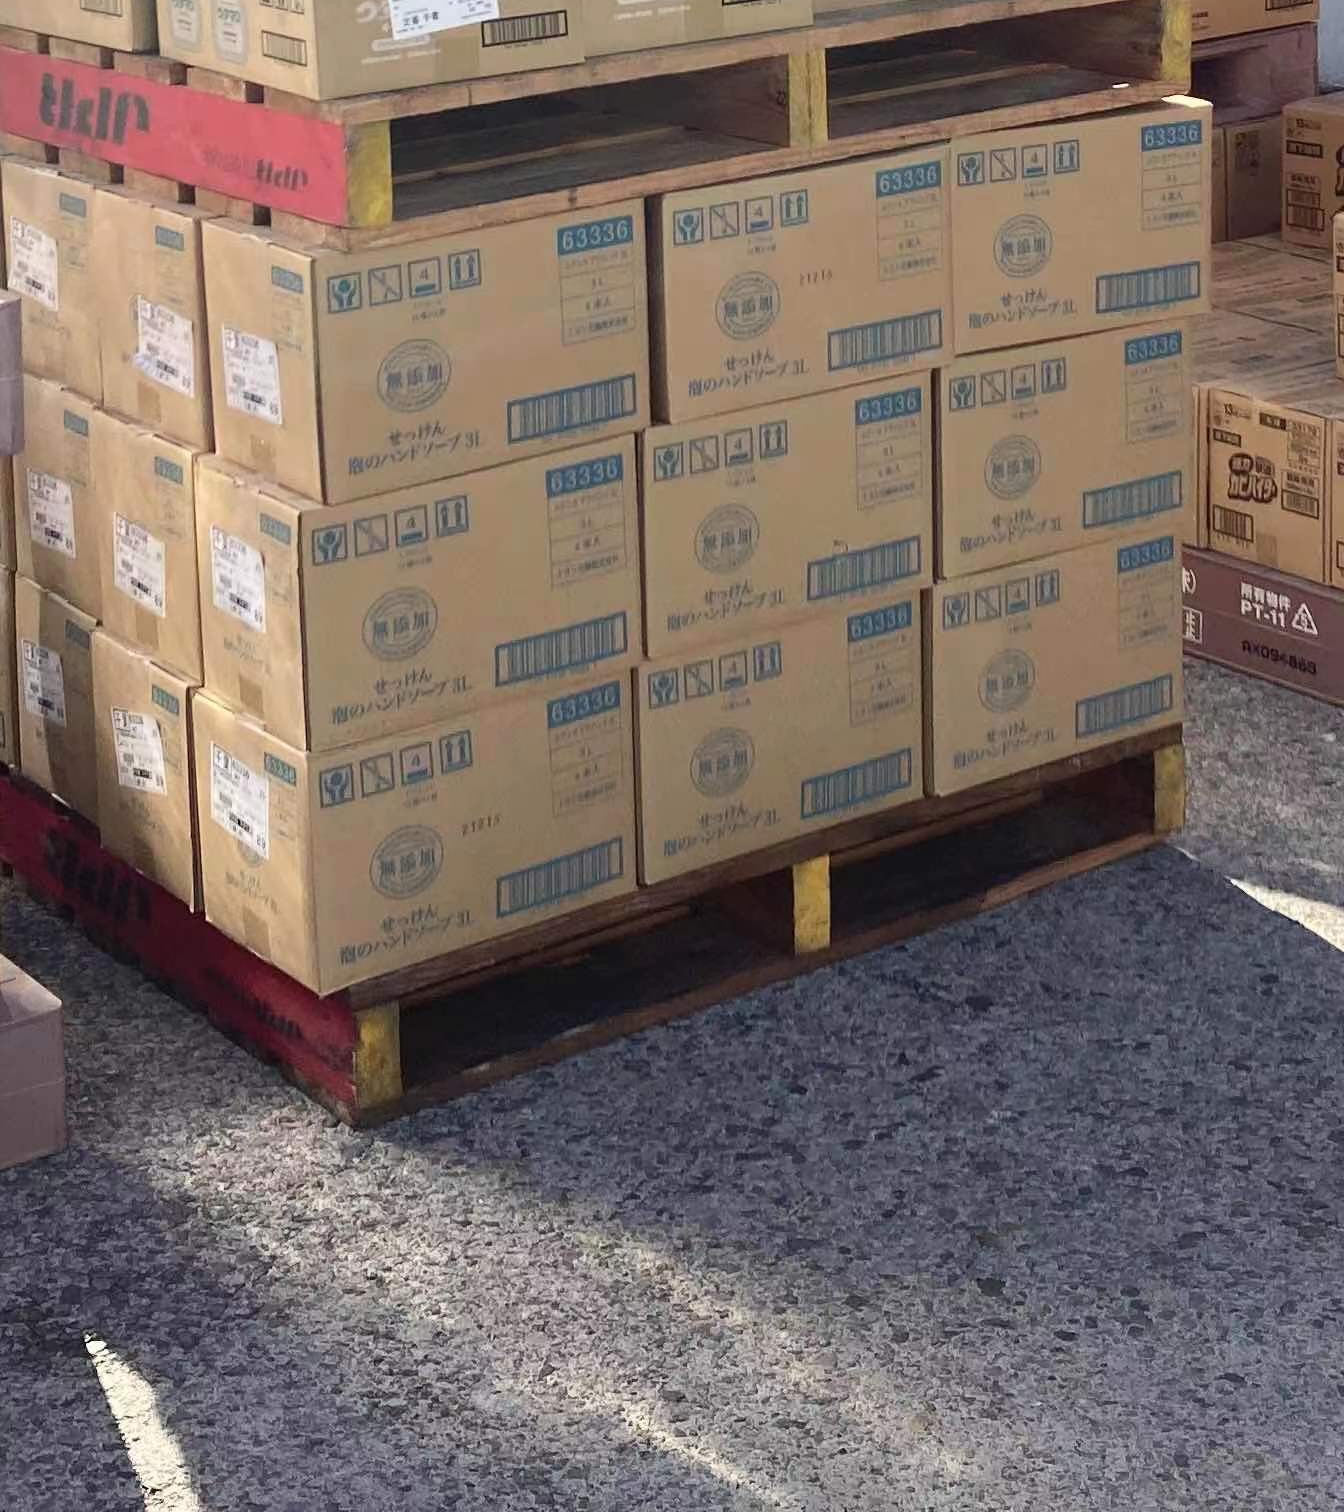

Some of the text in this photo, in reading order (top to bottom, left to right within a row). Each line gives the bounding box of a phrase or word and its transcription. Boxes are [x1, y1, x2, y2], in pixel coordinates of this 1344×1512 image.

[1144, 125, 1199, 147] 63336
[878, 164, 938, 194] 63336
[563, 220, 629, 252] 63336
[1127, 336, 1181, 361] 63336
[859, 392, 918, 420] 63336
[388, 420, 447, 443] せっけん
[1240, 602, 1285, 630] PT-11
